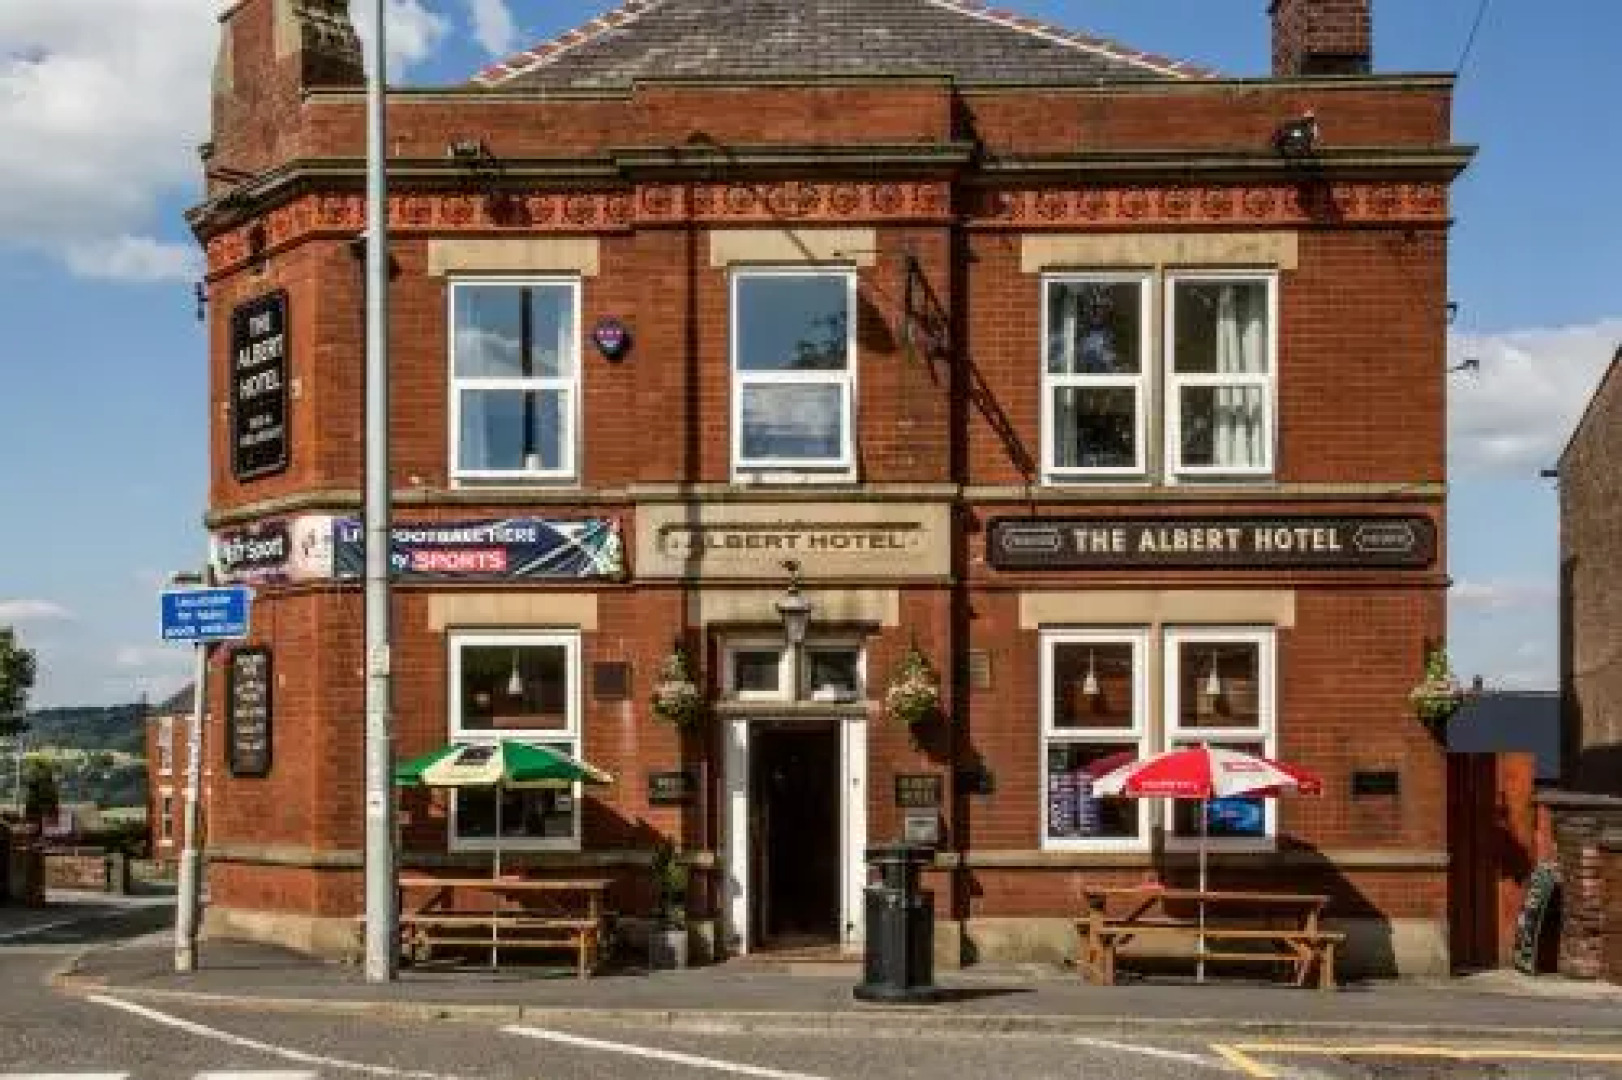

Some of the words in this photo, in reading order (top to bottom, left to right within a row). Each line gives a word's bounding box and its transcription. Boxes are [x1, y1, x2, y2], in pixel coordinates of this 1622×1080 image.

[239, 369, 281, 399] HOTEL
[810, 533, 906, 549] HOTEL
[1073, 527, 1126, 552] THE
[1139, 527, 1240, 552] ALBERT
[1254, 527, 1343, 552] HOTEL
[415, 552, 506, 570] SPORTS
